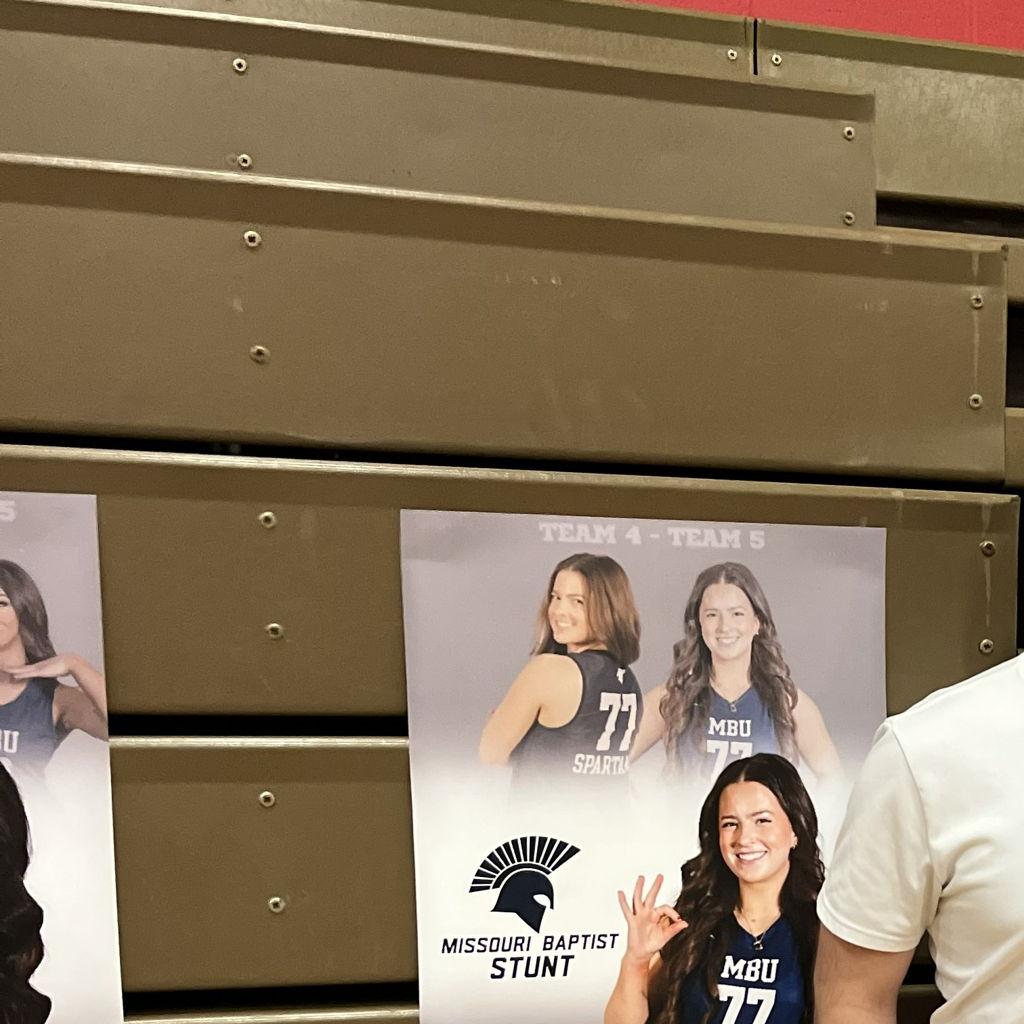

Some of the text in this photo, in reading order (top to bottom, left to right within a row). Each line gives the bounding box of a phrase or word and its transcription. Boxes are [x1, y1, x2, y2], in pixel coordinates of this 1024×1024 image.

[538, 521, 617, 545] TEAM
[624, 525, 642, 546] 4
[666, 526, 742, 549] TEAM
[749, 529, 765, 550] 5
[595, 691, 638, 752] 77
[707, 716, 752, 738] MBU
[441, 933, 620, 955] MISSOURI BAPTIST
[489, 954, 576, 980] STUNT
[720, 955, 780, 984] MBU
